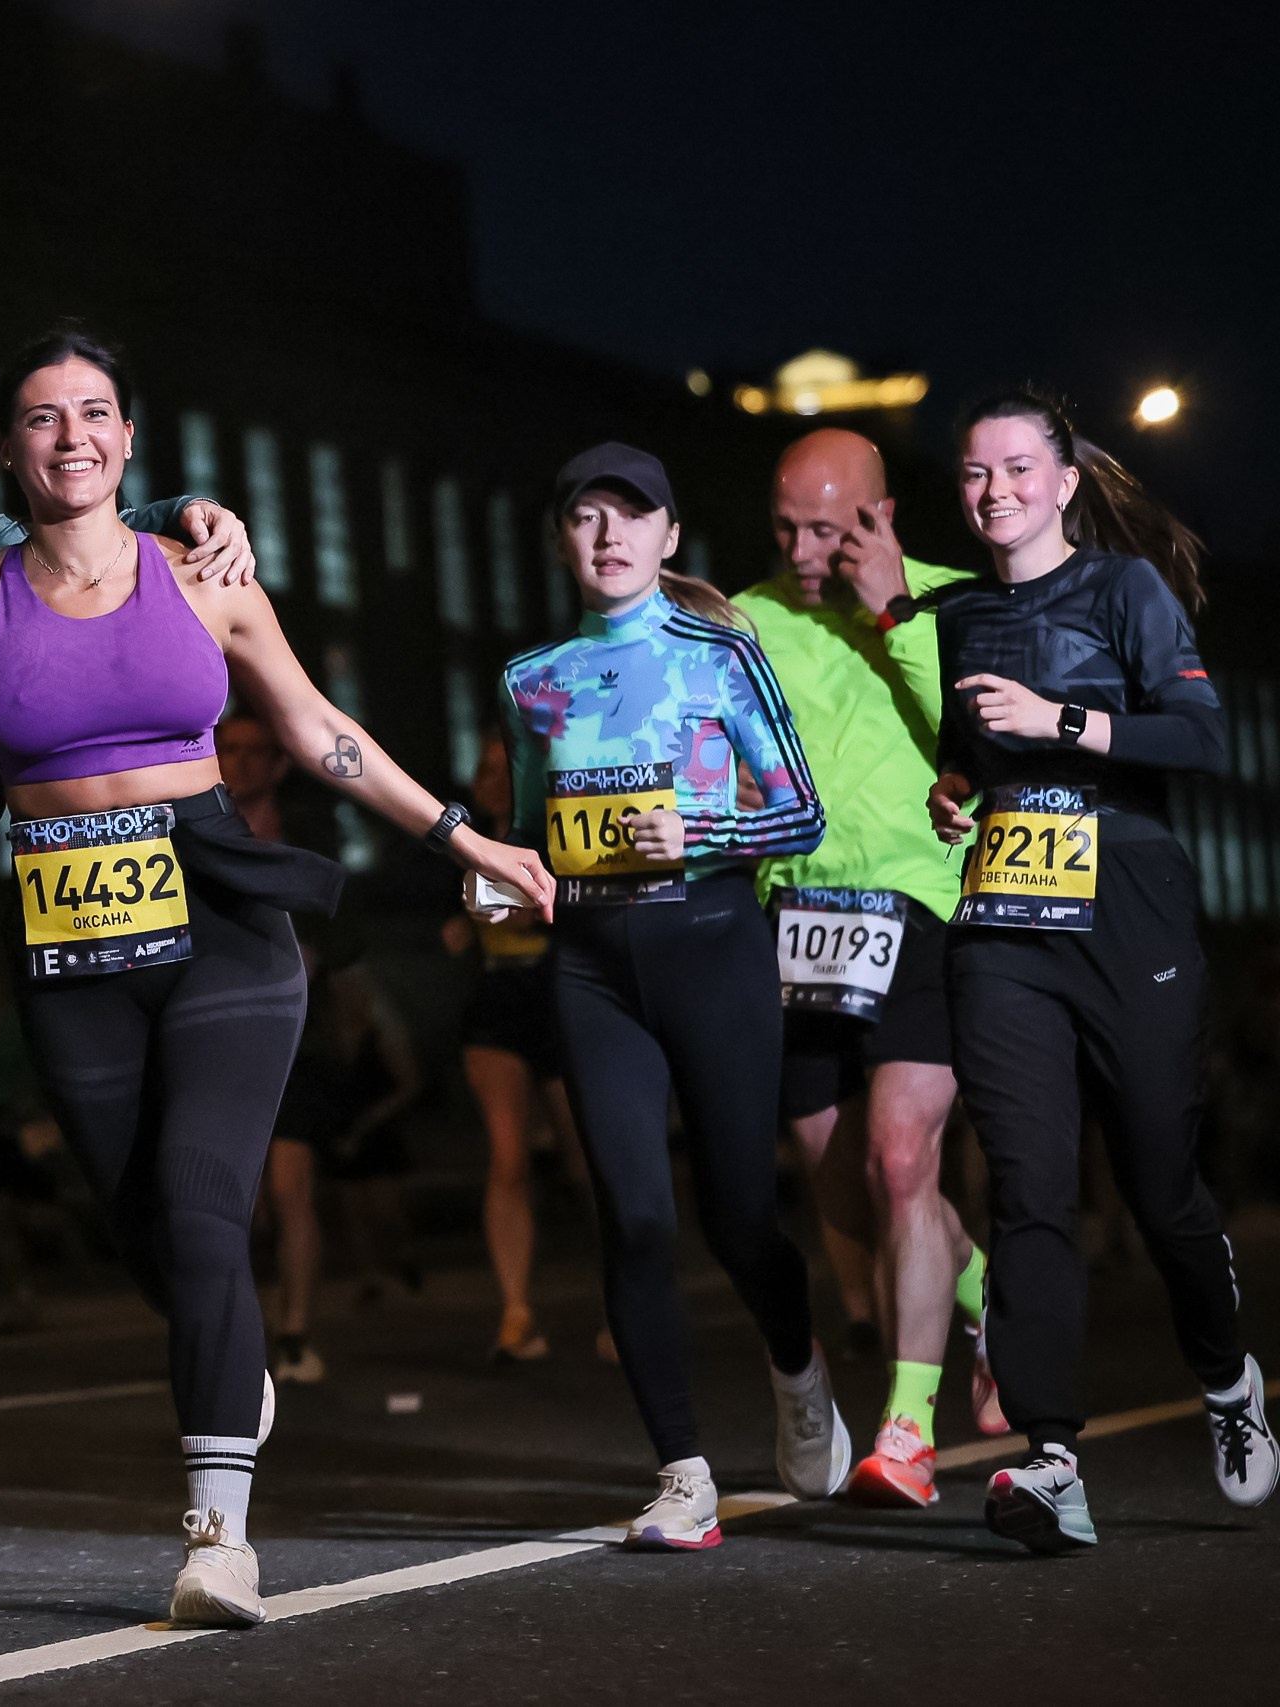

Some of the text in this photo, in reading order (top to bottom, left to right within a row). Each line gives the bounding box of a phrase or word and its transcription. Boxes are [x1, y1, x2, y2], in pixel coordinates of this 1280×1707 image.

[974, 825, 1091, 872] 19212
[26, 853, 178, 914] 14432
[979, 871, 1058, 887] СВЕТАЛАНА
[73, 911, 132, 930] ОКСАНА
[43, 948, 61, 975] E
[786, 922, 893, 968] 10193
